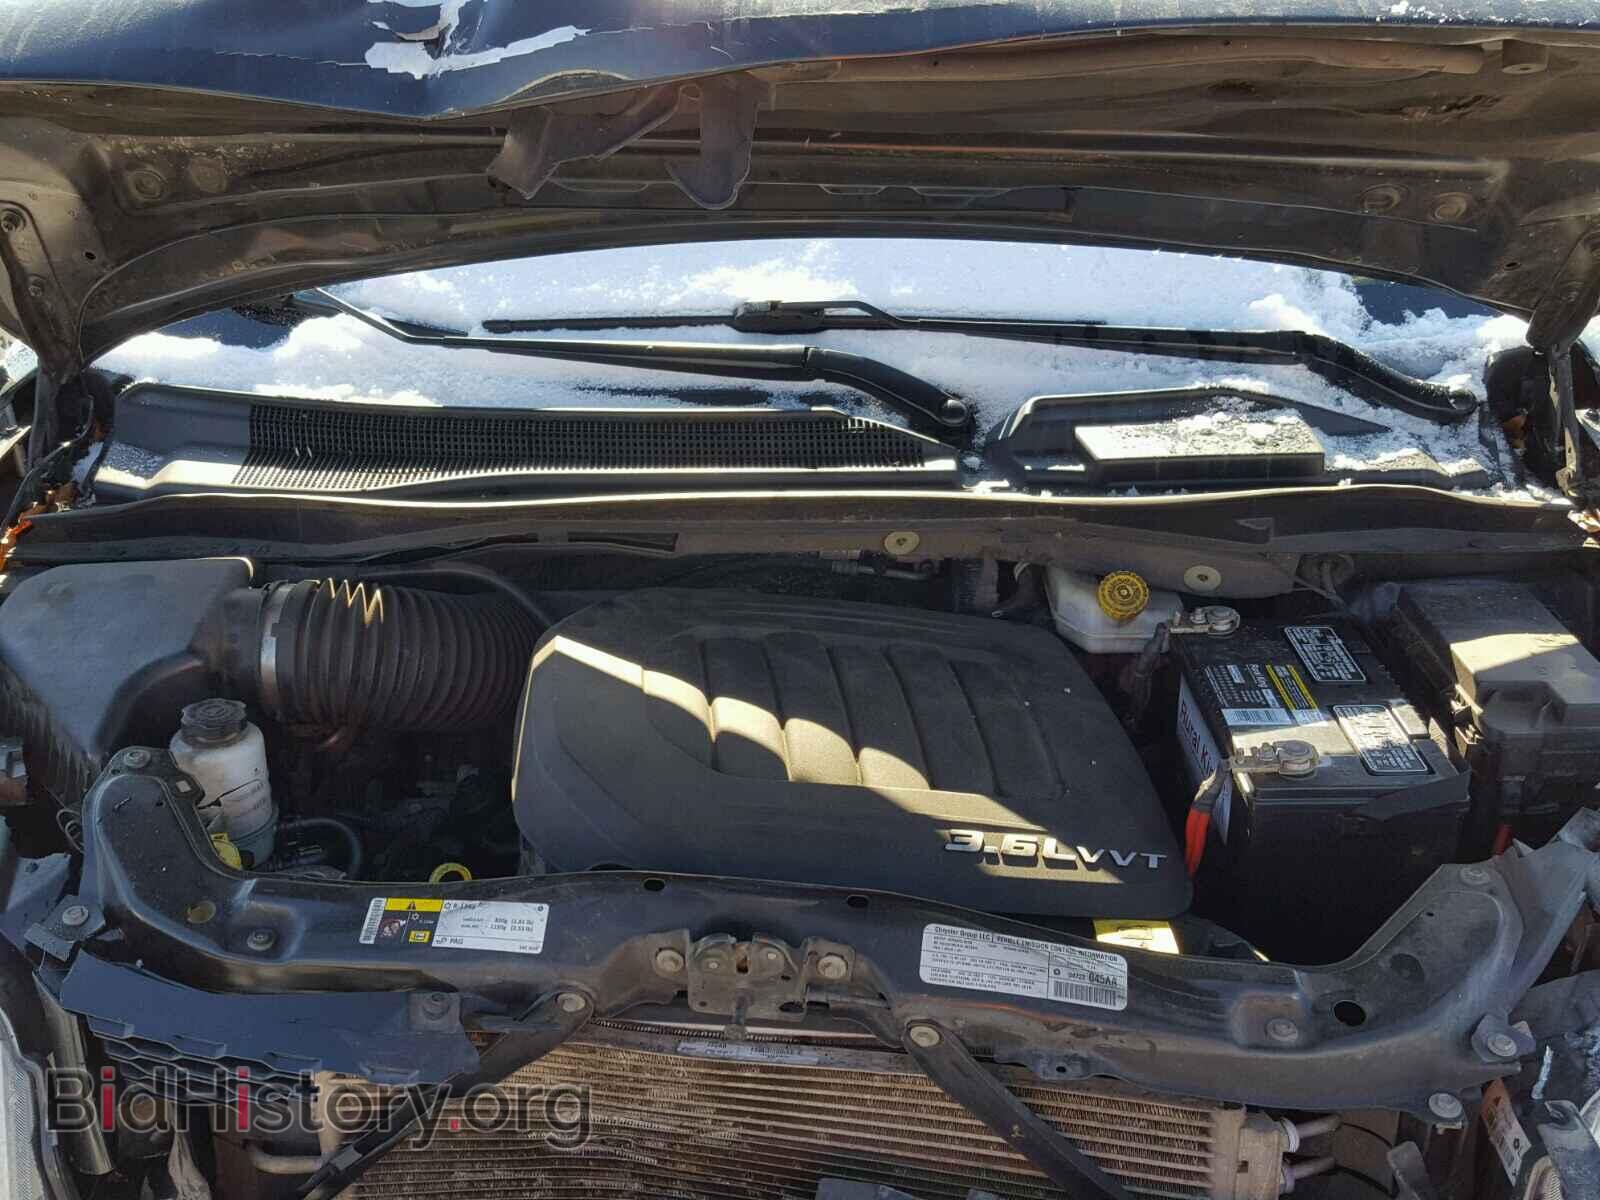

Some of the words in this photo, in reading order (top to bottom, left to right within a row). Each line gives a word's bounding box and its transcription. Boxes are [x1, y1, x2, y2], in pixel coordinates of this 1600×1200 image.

[1179, 699, 1201, 753] Rural
[934, 926, 958, 935] Chrysler
[960, 929, 978, 938] Group
[979, 932, 991, 941] LLC
